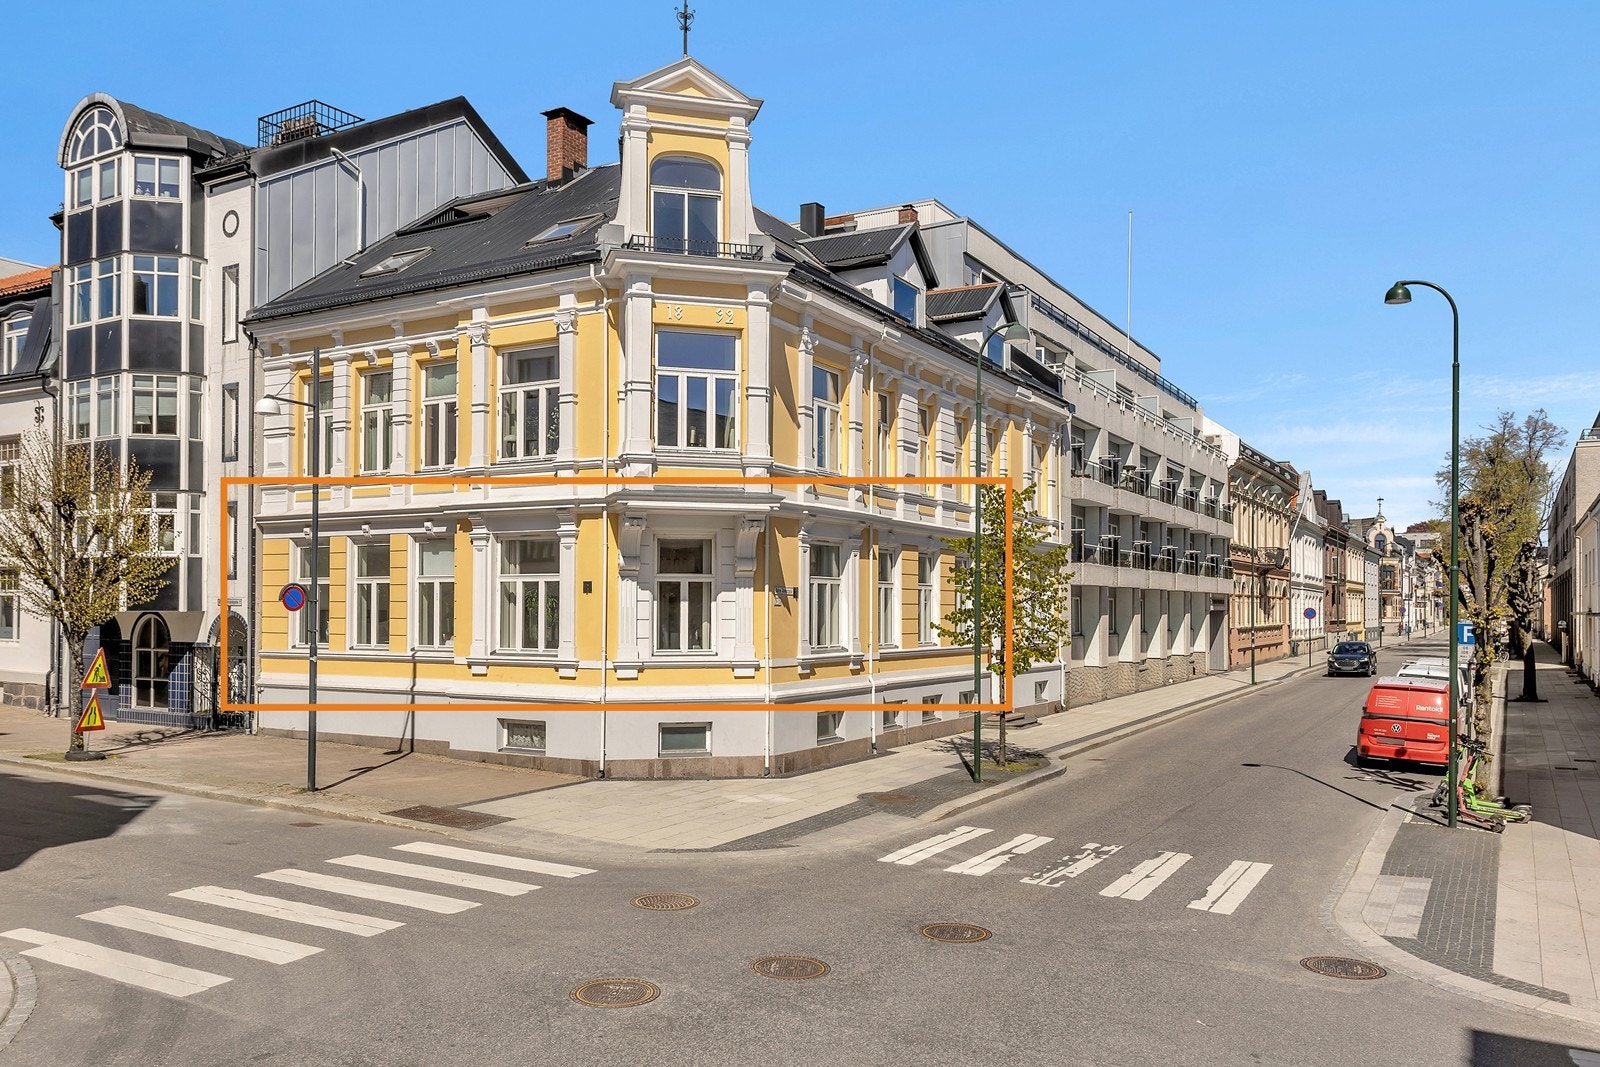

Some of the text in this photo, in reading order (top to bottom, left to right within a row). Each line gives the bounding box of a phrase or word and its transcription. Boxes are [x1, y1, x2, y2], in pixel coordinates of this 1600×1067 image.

[667, 304, 734, 325] 18 92
[1415, 704, 1444, 713] Rentokil
